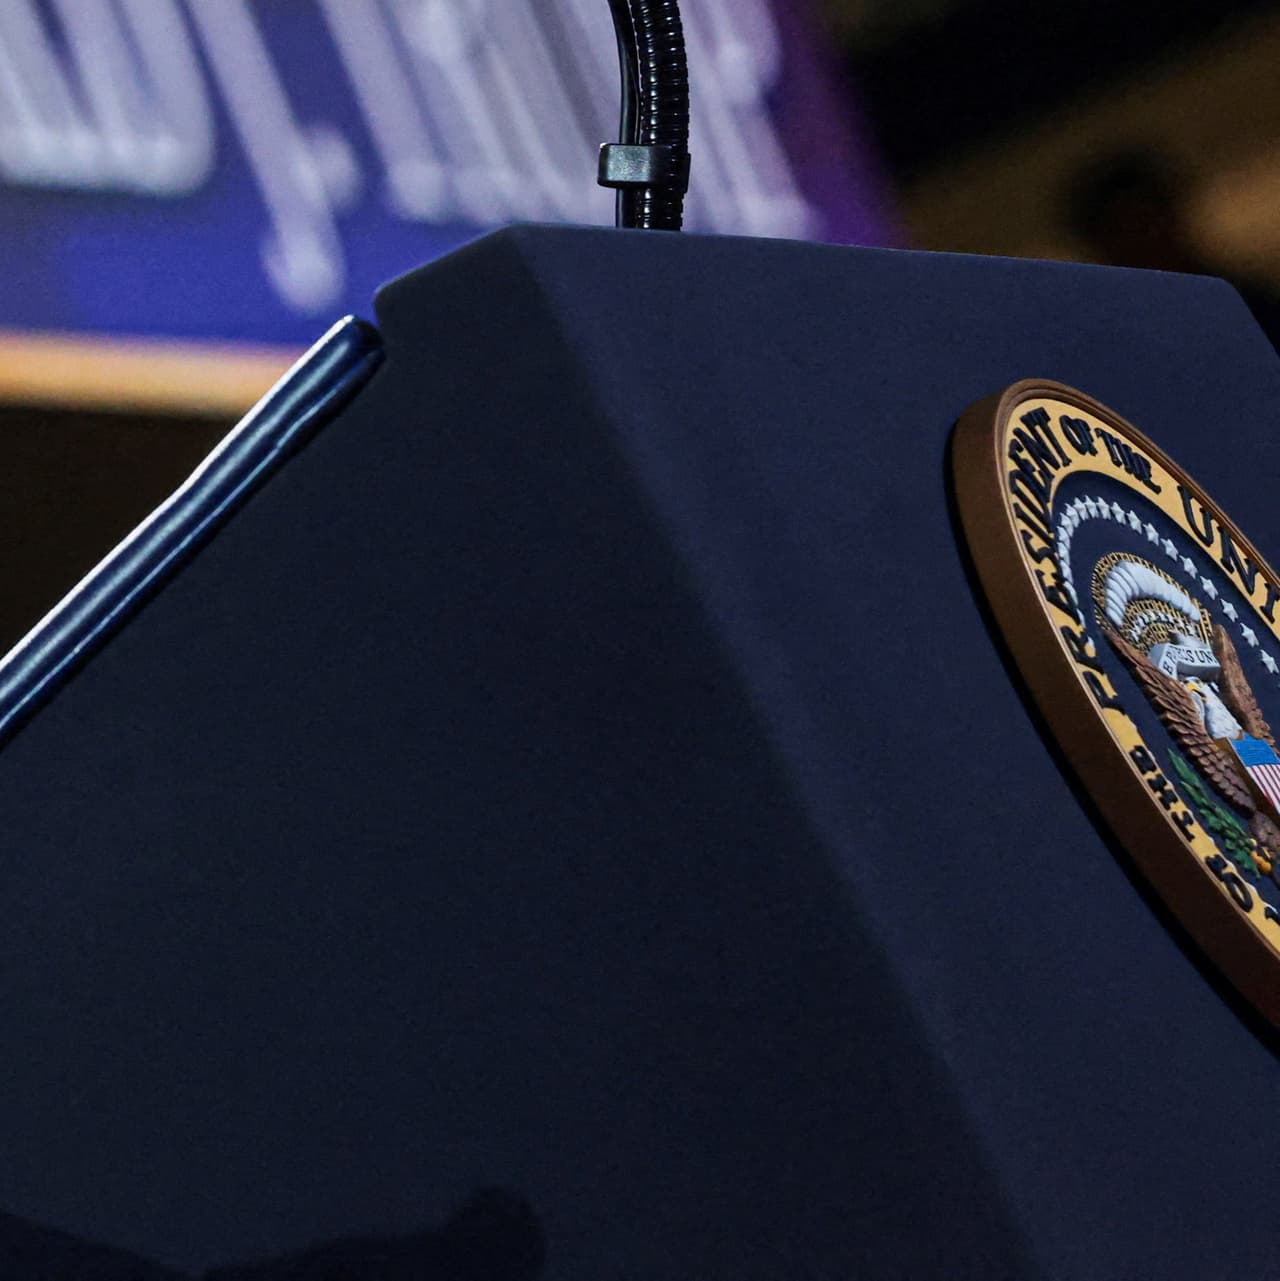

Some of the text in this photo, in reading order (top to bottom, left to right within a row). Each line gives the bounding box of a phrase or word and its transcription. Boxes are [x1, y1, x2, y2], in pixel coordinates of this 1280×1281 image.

[1059, 415, 1098, 456] OF
[1094, 427, 1161, 494] THE
[1008, 407, 1124, 716] PRESIDENT
